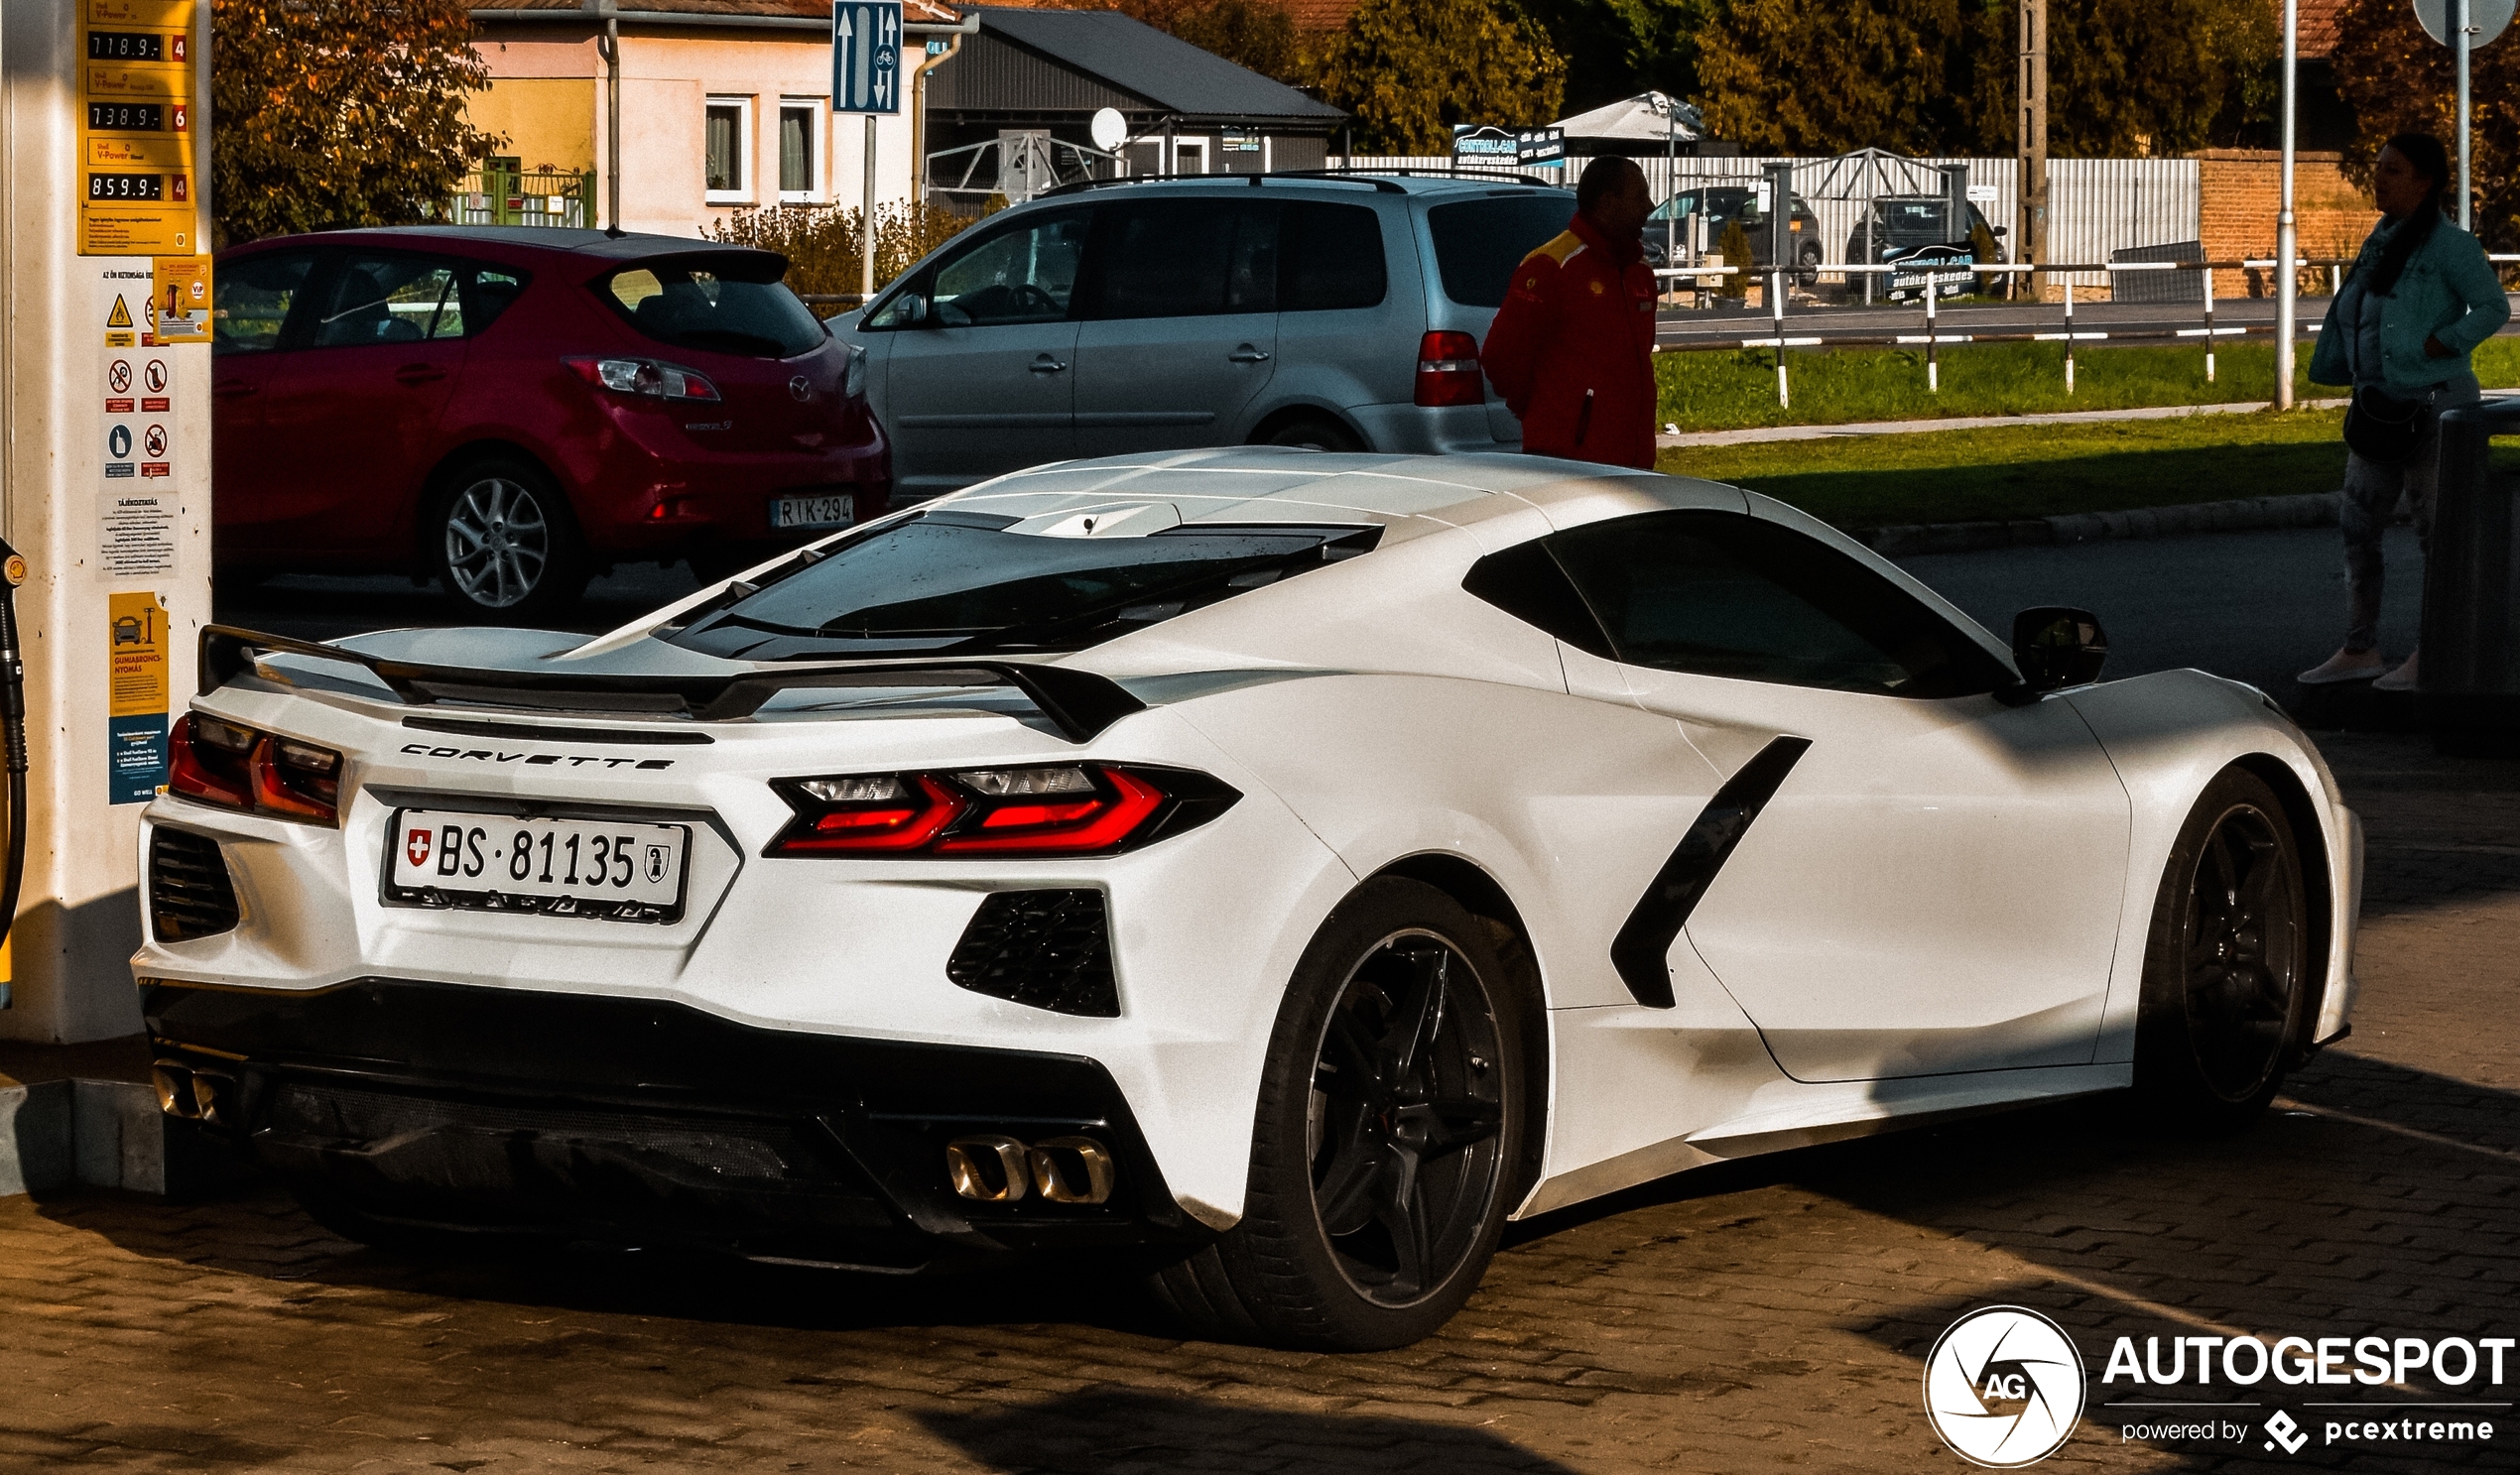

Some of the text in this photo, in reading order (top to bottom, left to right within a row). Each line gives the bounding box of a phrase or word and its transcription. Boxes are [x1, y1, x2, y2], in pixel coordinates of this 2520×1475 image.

[175, 41, 185, 57] 4
[175, 110, 186, 127] 6
[1458, 139, 1517, 154] CONTROLL-CAR
[97, 151, 128, 160] V-Power
[176, 180, 186, 196] 4
[782, 497, 850, 524] RIK-294
[114, 664, 142, 675] NYOMÁS
[400, 743, 676, 770] CORVETTE
